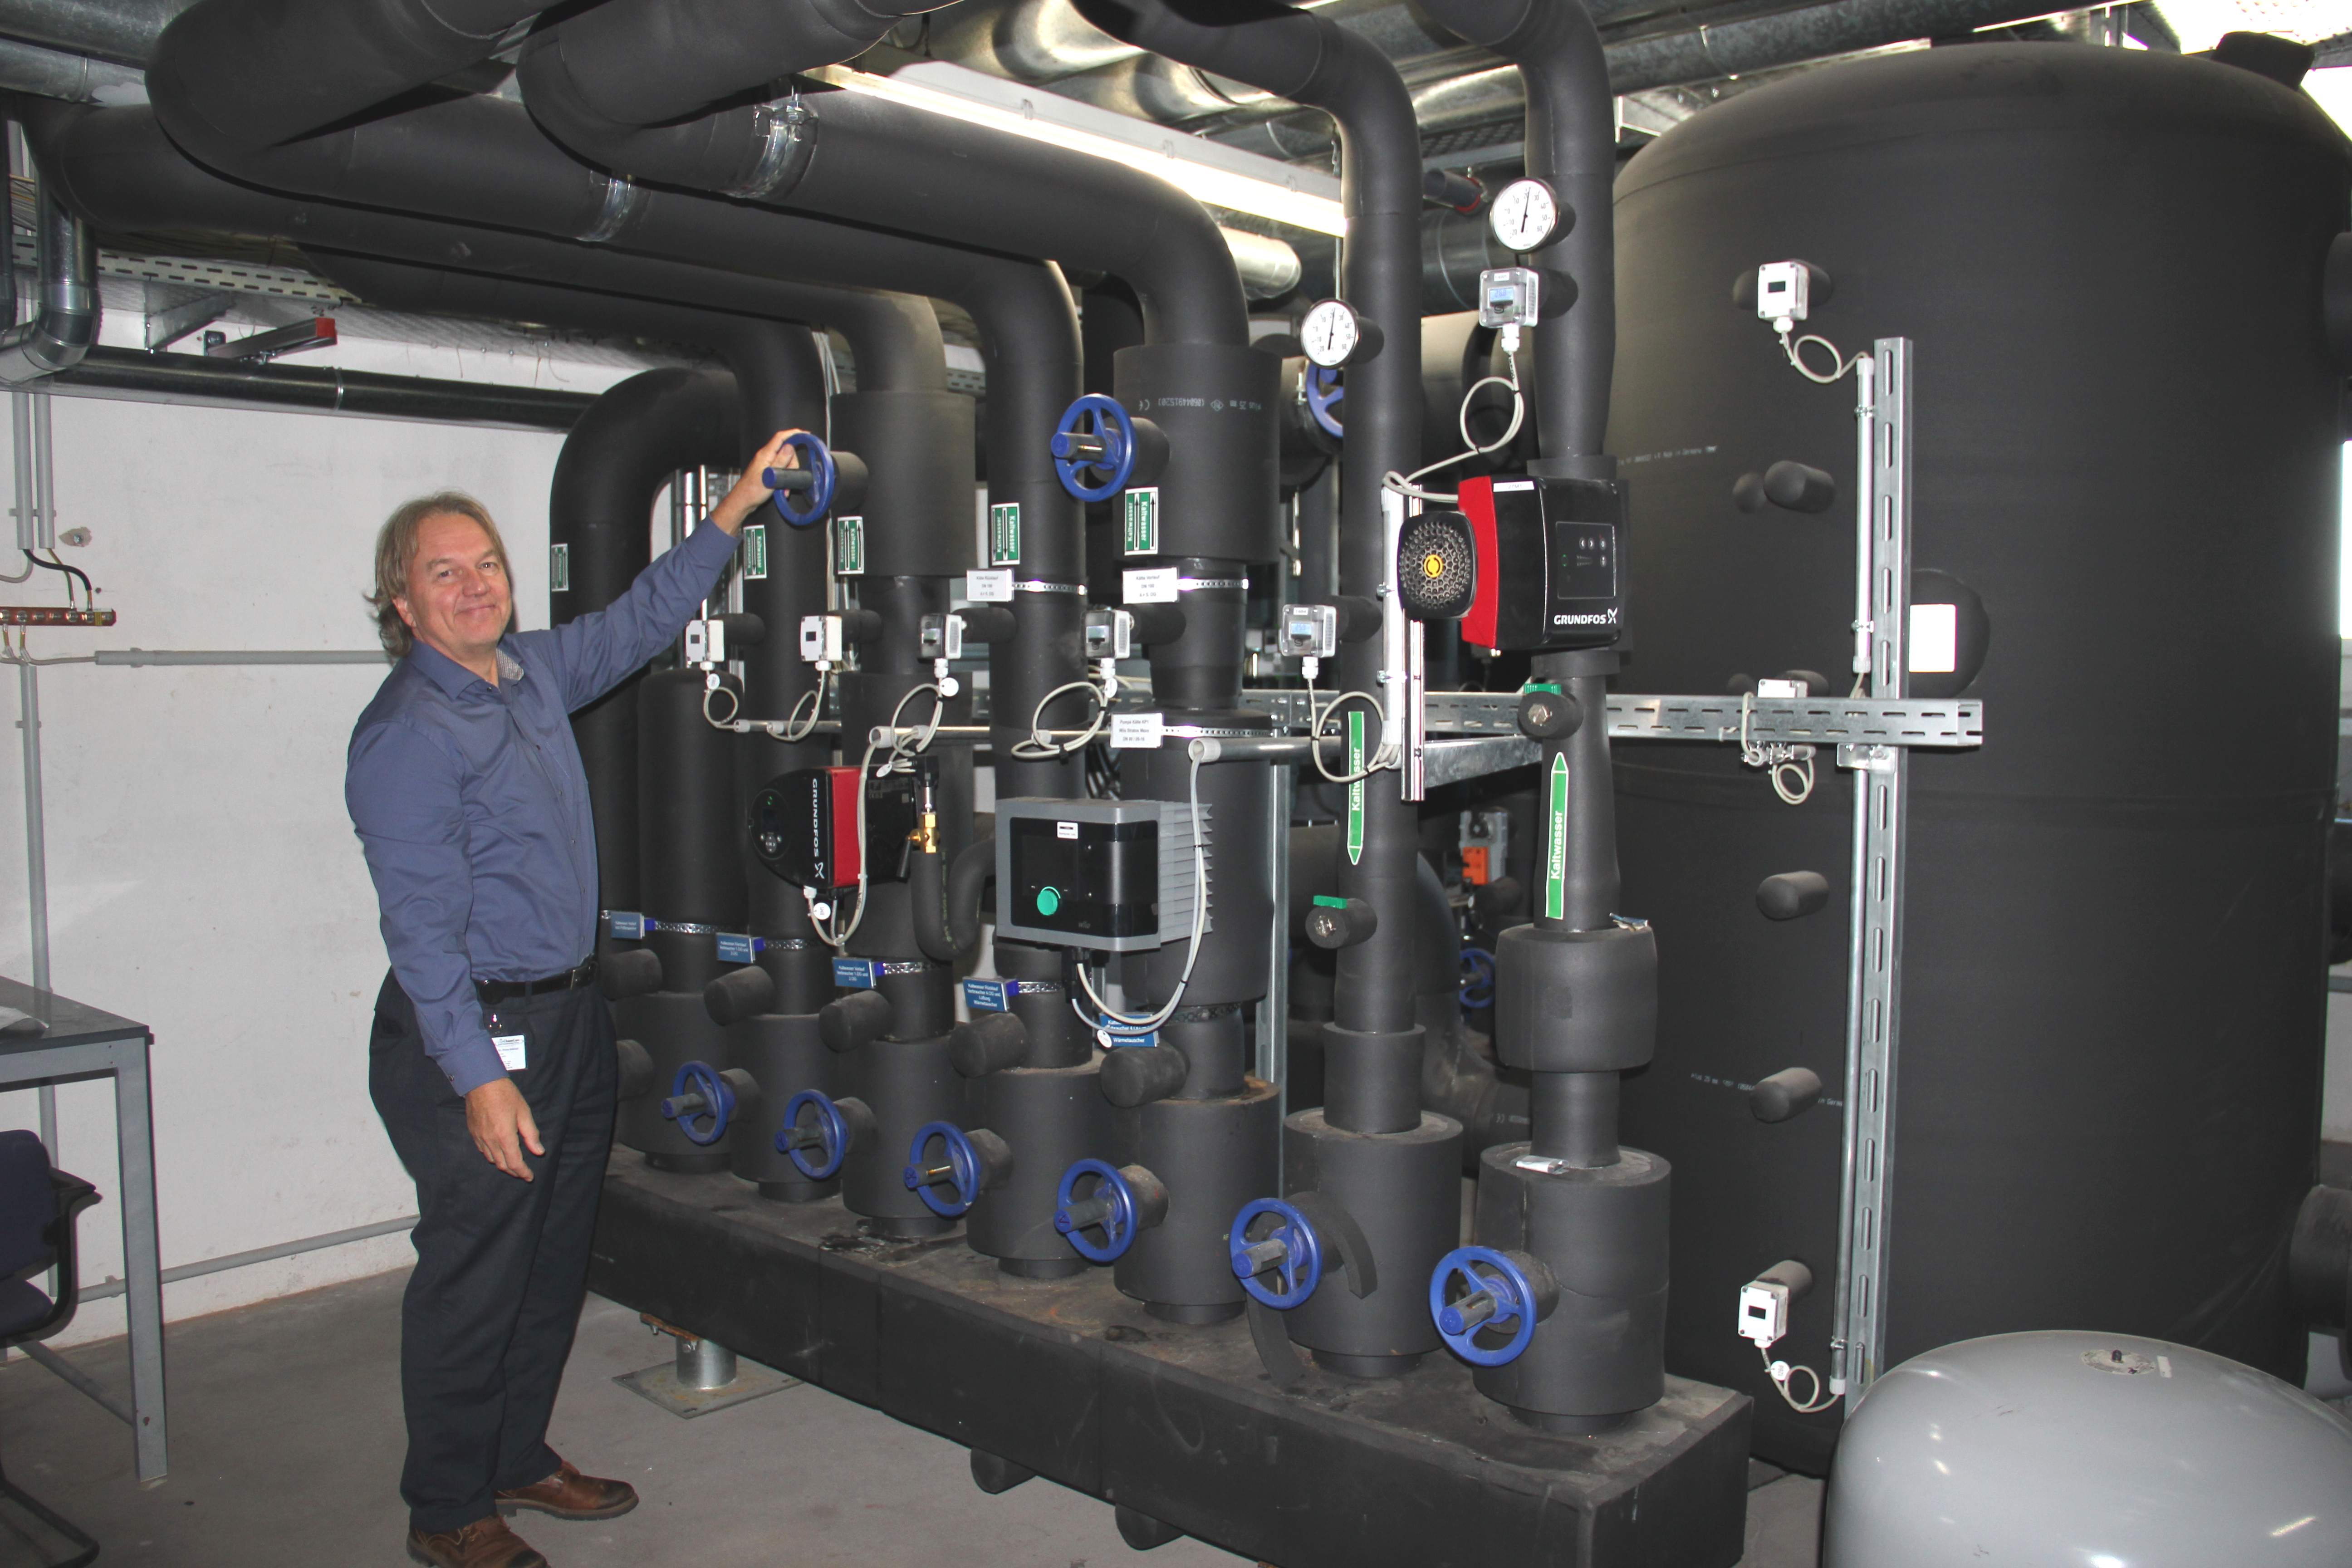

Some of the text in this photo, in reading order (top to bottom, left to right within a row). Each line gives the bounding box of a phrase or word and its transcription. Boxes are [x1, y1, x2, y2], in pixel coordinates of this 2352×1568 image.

[1553, 614, 1607, 625] GRUNDFOS
[1352, 747, 1361, 811] Kaltwsser
[1551, 810, 1563, 879] Kaltwasser
